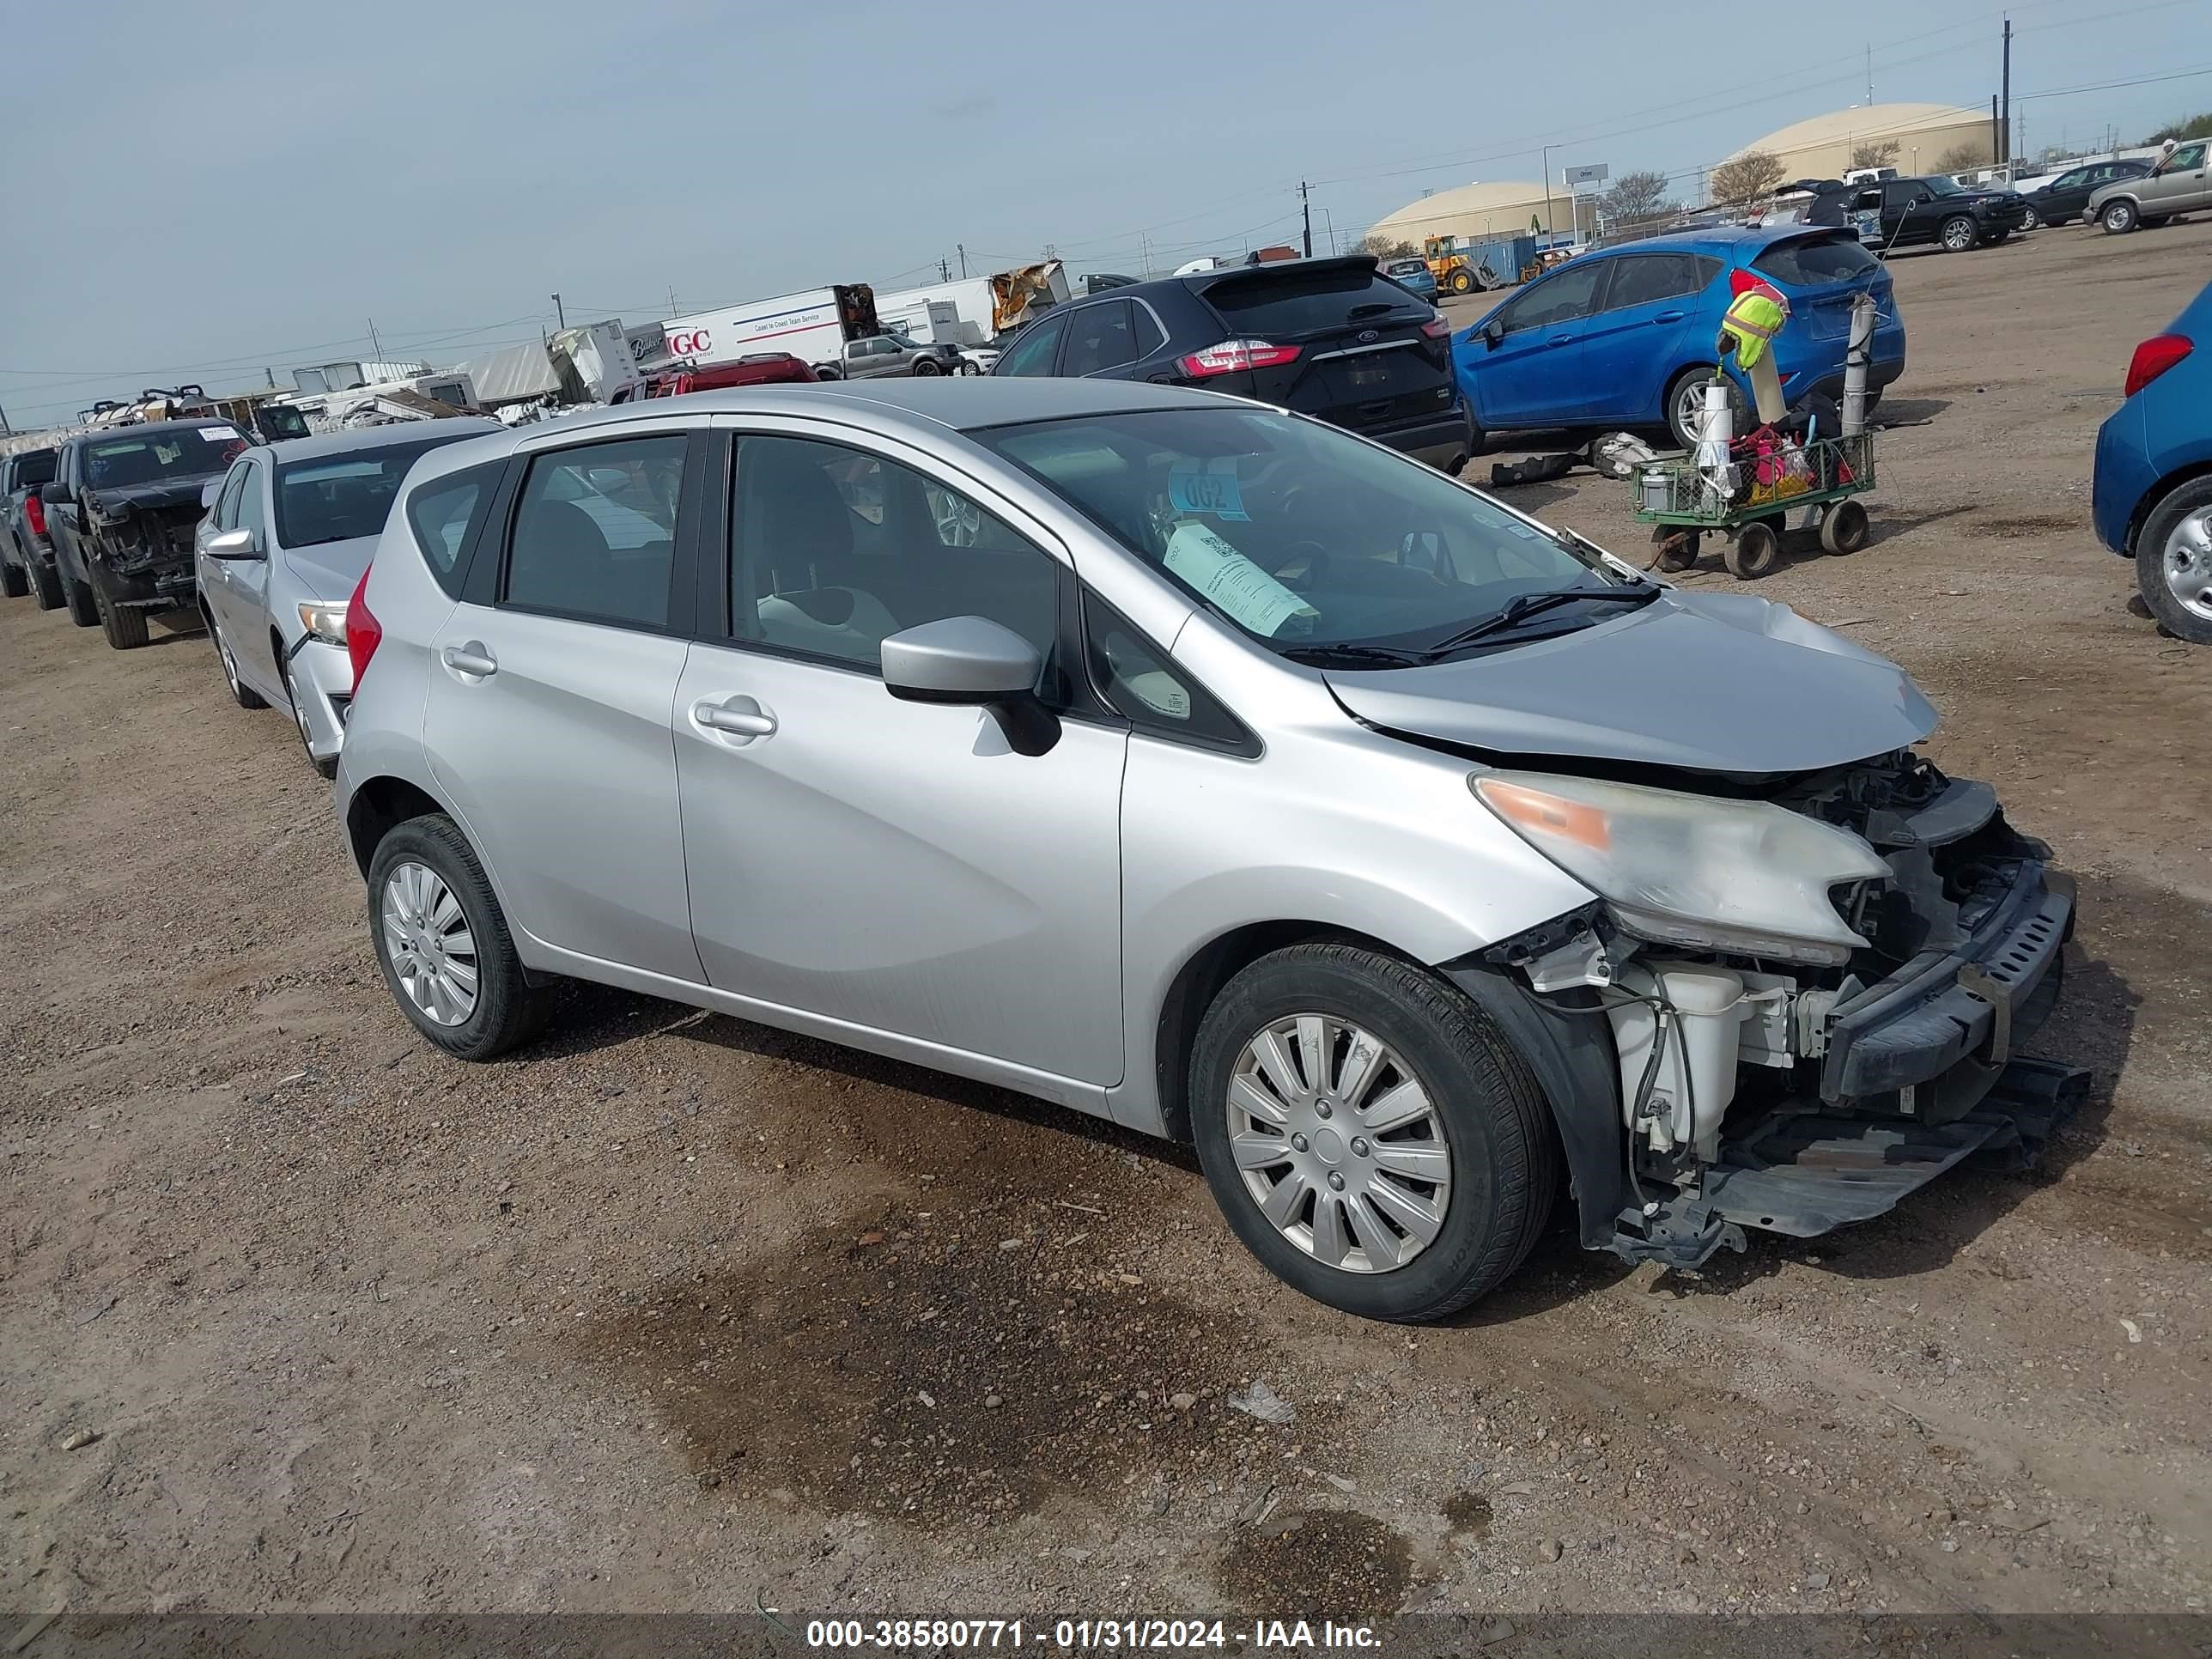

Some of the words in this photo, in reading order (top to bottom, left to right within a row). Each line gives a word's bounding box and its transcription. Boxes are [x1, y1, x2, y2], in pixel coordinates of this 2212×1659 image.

[755, 323, 769, 331] Coast
[788, 317, 801, 325] Team
[801, 314, 819, 323] Service
[1170, 545, 1181, 562] 002
